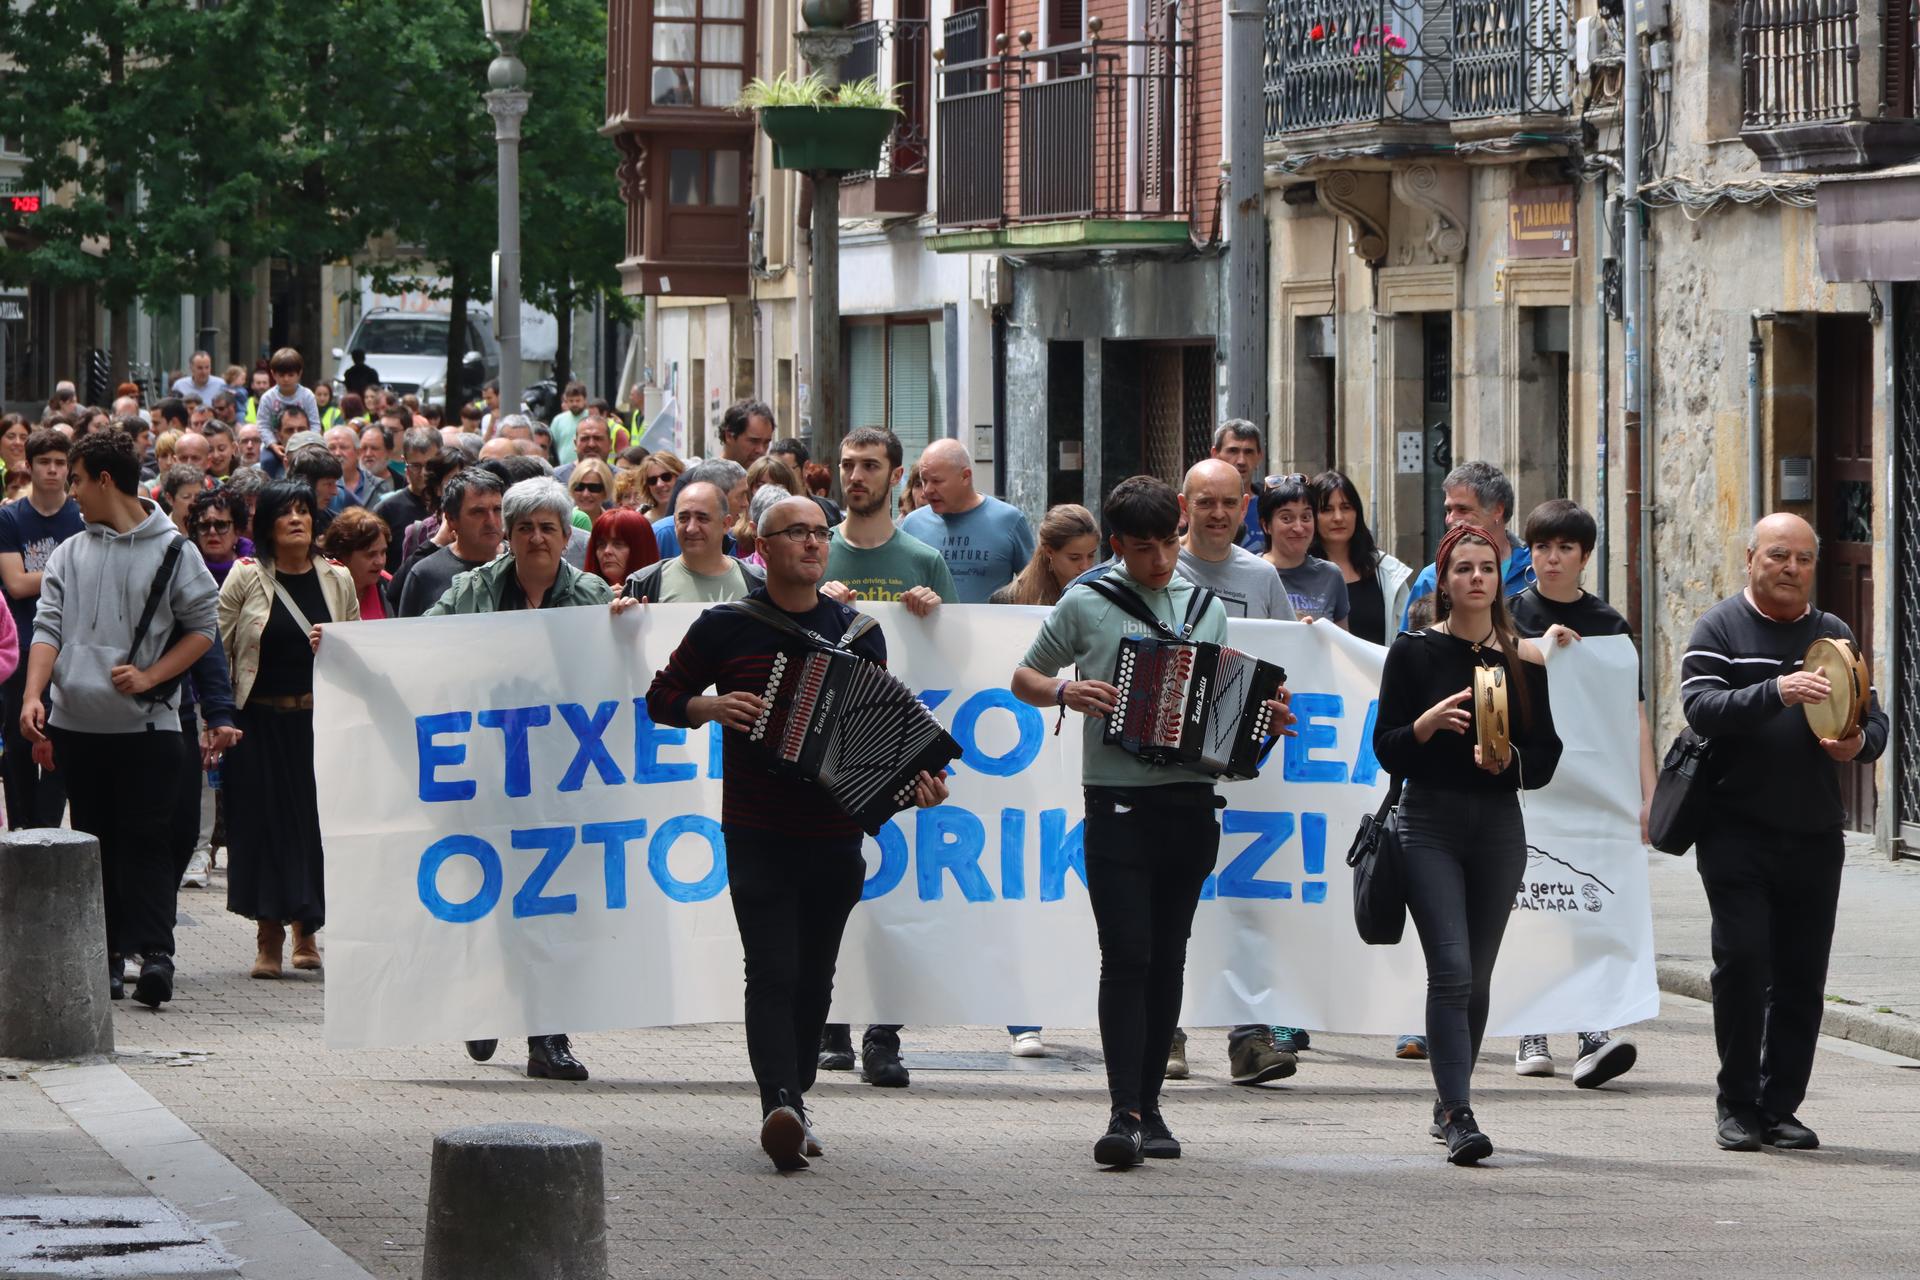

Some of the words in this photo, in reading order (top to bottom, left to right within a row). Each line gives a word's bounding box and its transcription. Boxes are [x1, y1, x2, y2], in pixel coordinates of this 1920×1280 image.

[1522, 203, 1571, 227] TABAKOAK
[943, 536, 970, 546] INTO
[1200, 809, 1328, 904] Z!
[1531, 882, 1574, 898] gertu
